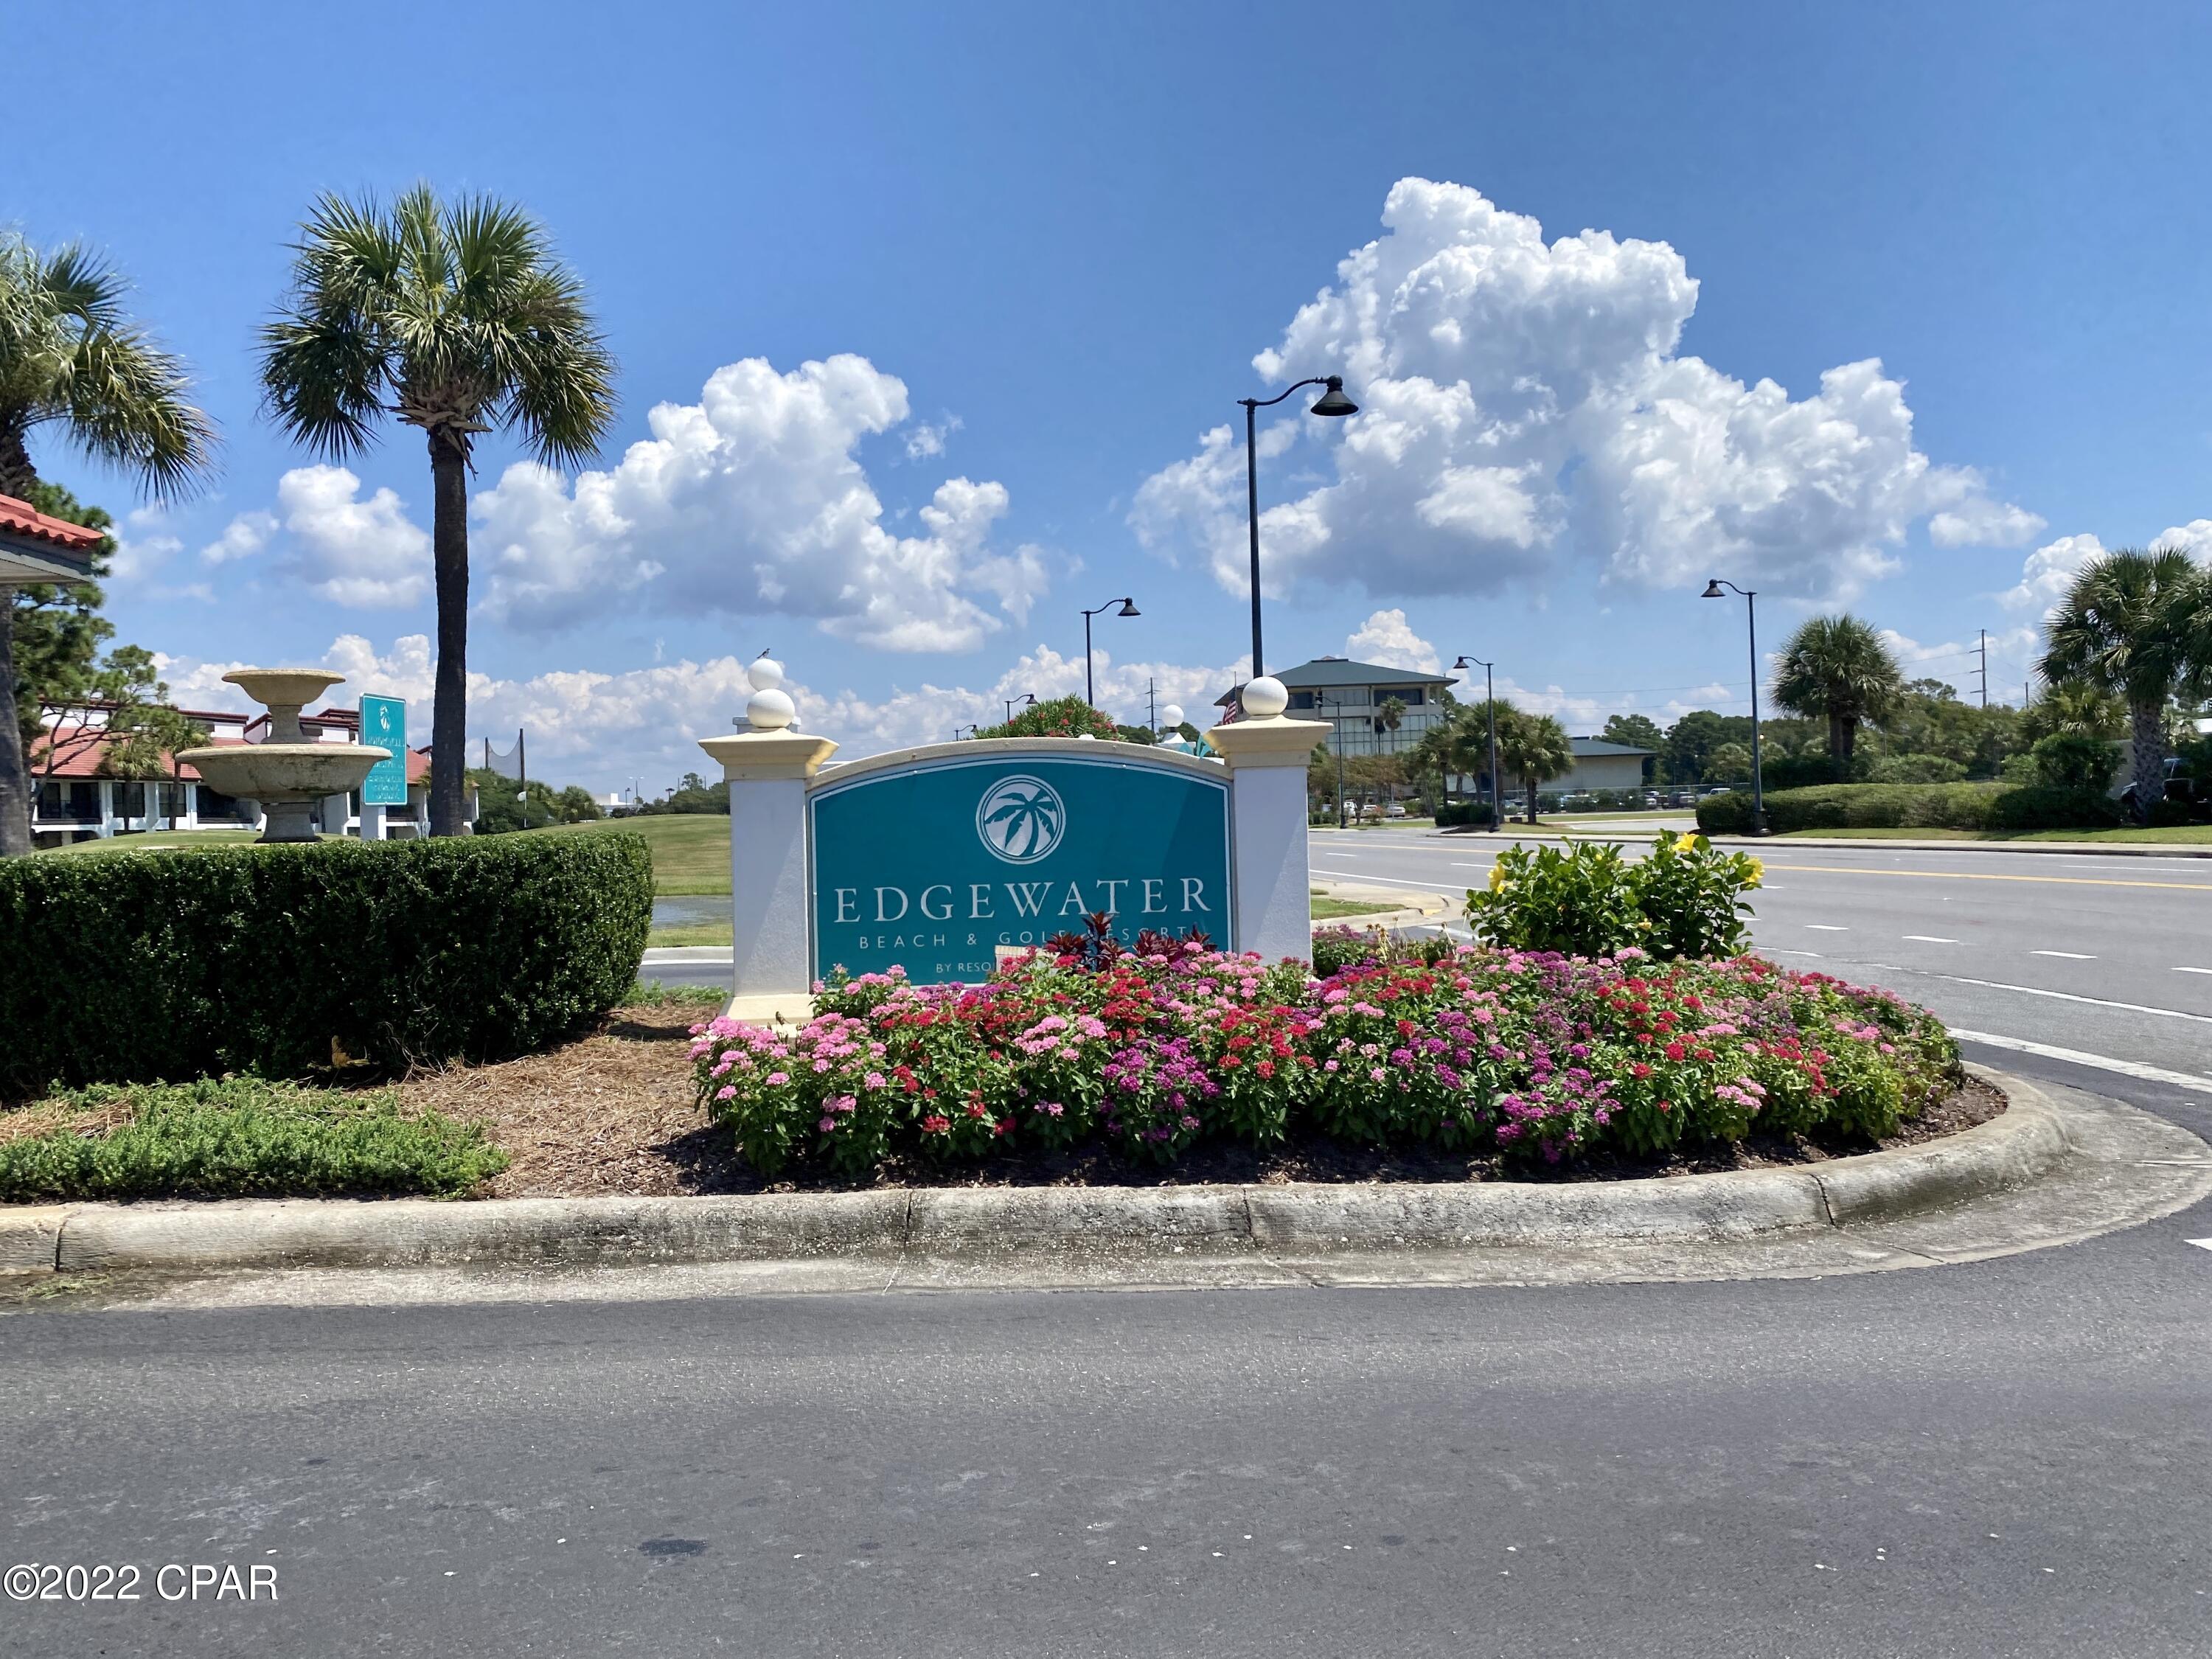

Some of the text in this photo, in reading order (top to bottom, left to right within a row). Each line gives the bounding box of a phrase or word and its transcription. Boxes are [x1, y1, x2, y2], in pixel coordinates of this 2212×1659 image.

[833, 877, 1211, 923] EDGEWATER
[859, 933, 945, 949] BEACH
[967, 933, 977, 945] &
[1087, 926, 1187, 942] ESRT
[936, 963, 951, 973] BY
